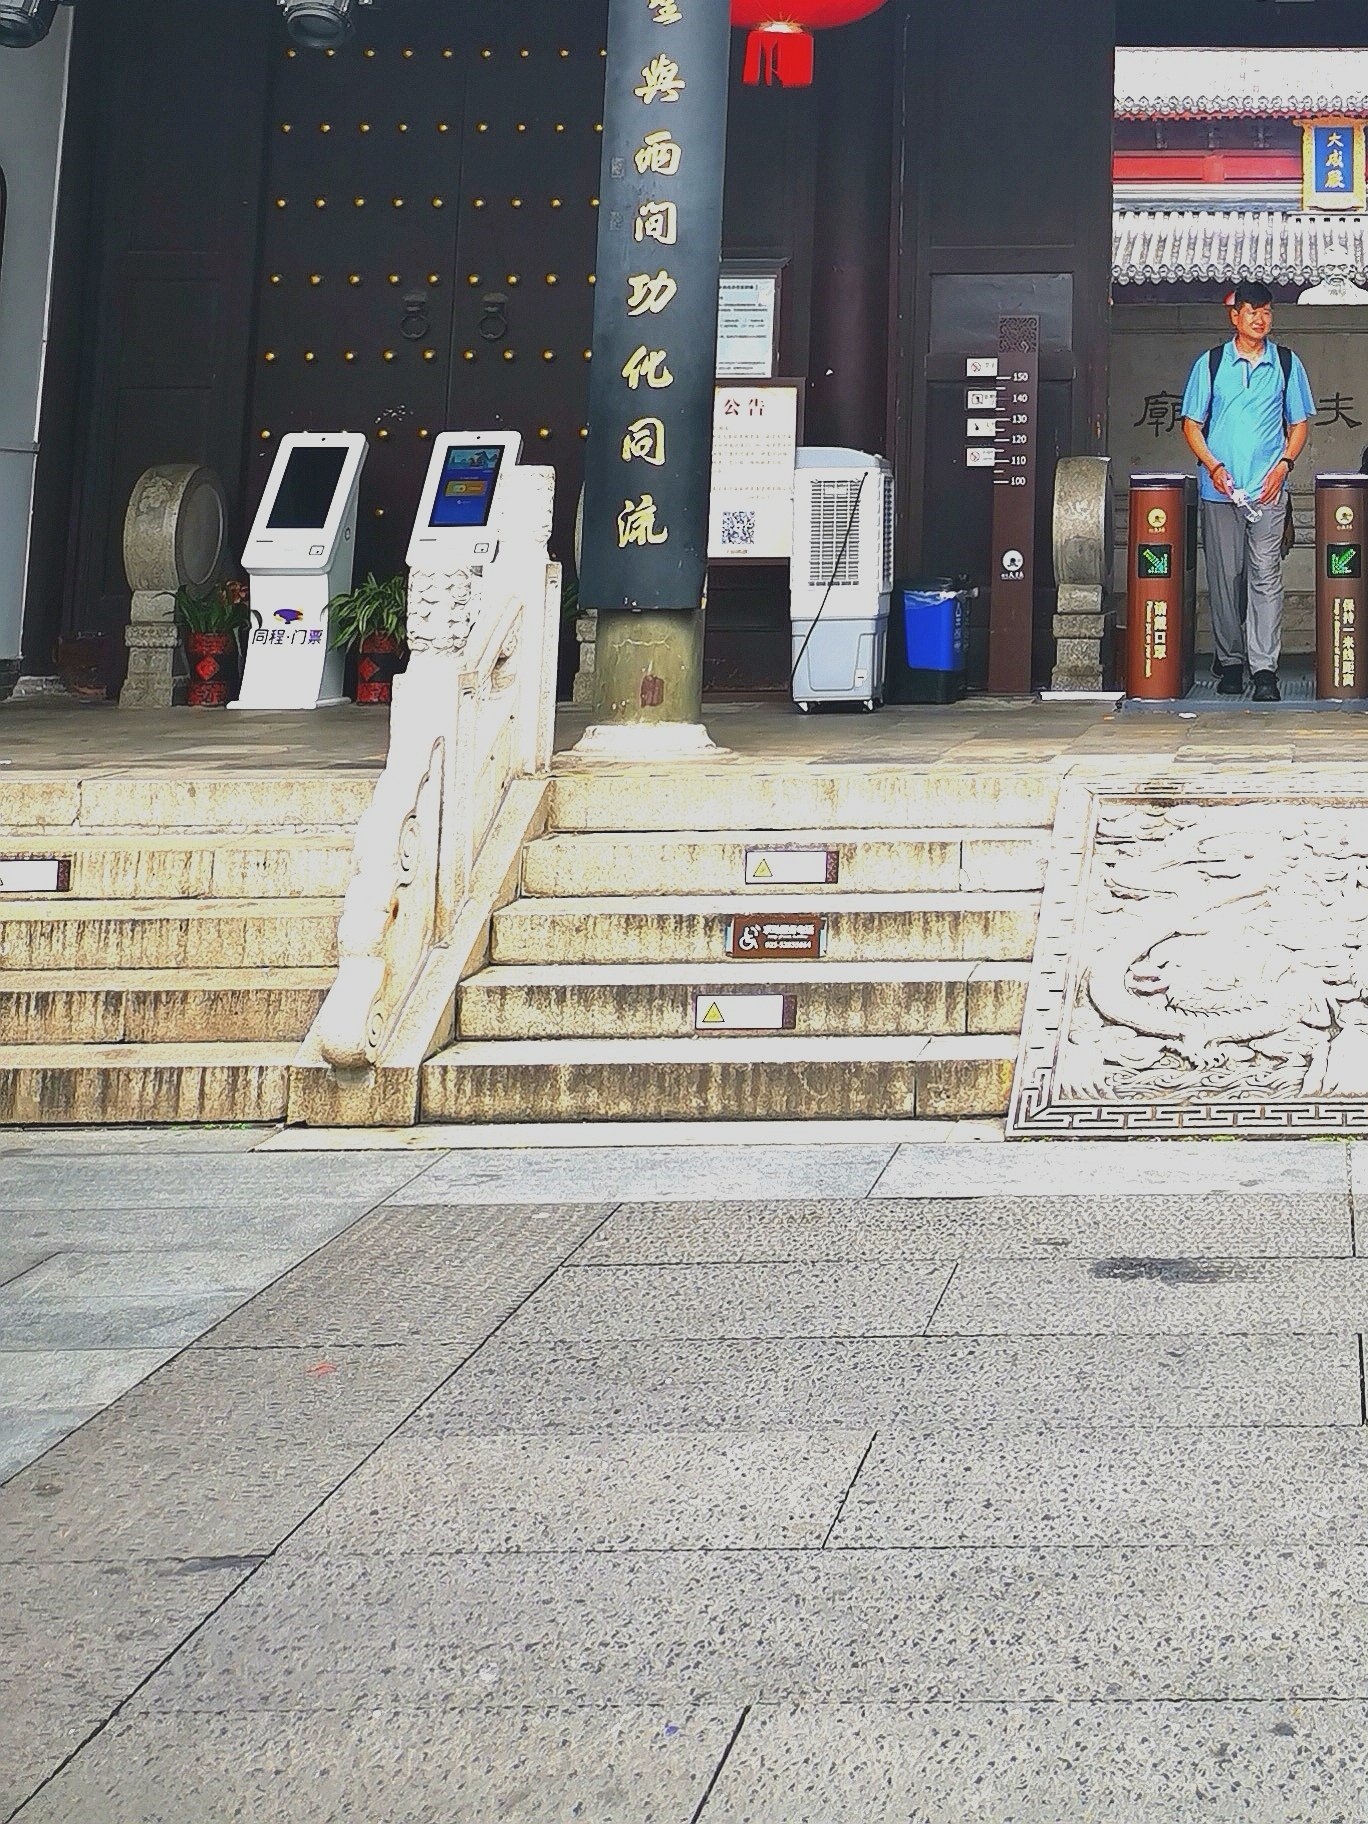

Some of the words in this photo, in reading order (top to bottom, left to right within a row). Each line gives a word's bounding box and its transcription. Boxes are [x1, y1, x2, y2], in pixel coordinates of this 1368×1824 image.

[1013, 372, 1029, 382] 150
[1012, 393, 1028, 403] 140
[1012, 414, 1028, 424] 130
[1012, 434, 1028, 444] 120
[1011, 455, 1027, 466] 110
[1010, 476, 1026, 486] 100
